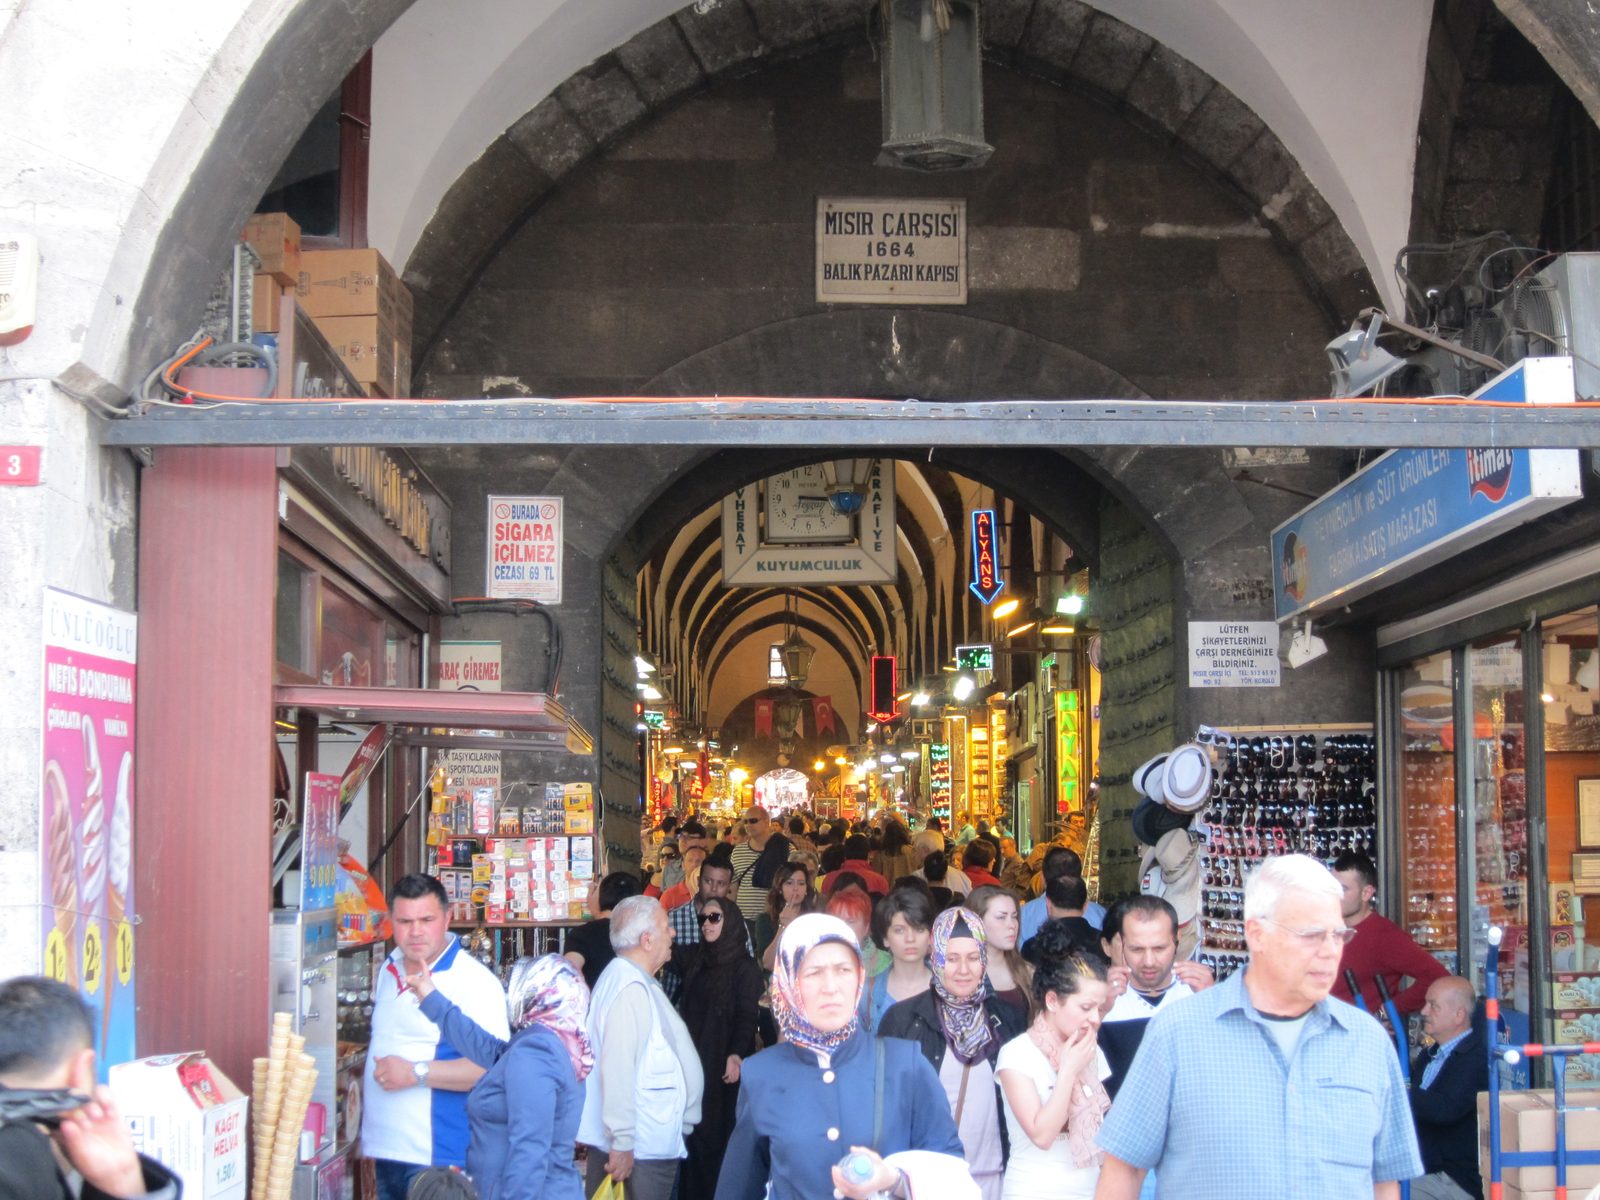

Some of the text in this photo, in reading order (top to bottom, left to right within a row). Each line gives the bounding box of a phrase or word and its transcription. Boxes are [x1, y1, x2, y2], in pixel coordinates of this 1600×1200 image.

[825, 212, 958, 238] MISIR ÇARŞISI
[867, 242, 914, 256] 1664
[916, 265, 958, 282] KAPISI
[8, 454, 20, 476] 3
[782, 480, 790, 488] 10
[1365, 491, 1376, 512] ve
[1377, 468, 1396, 504] SÜT
[776, 494, 782, 503] 9
[512, 505, 540, 520] BURADA
[792, 518, 797, 526] 7
[806, 521, 812, 530] 6
[820, 518, 826, 526] 5
[1361, 526, 1386, 558] SATIŞ
[1387, 498, 1438, 544] MAĞAZASI
[496, 522, 554, 542] SİGARA
[495, 543, 555, 564] İÇİLMEZ
[978, 513, 992, 588] ALYANS
[495, 566, 554, 580] CEZASI 69 TL
[756, 560, 862, 572] KUYUMCULUK
[1220, 624, 1248, 634] LÜTFEN
[1202, 636, 1266, 647] ŞİKAYETLERİNİZİ
[1196, 647, 1274, 658] ÇARŞI DERNEĞİMİZE
[440, 656, 500, 686] ARAÇ GİREMEZ
[48, 657, 132, 704] NEFİS DONDURMA
[1060, 692, 1076, 800] HAYAT
[452, 752, 500, 763] TAŞIYICILARININ
[448, 764, 498, 775] İŞPORTACILARIN
[467, 778, 498, 786] YASAKTIR
[84, 934, 95, 982] 2
[215, 1112, 240, 1137] KAĞIT
[214, 1134, 238, 1158] HELVA
